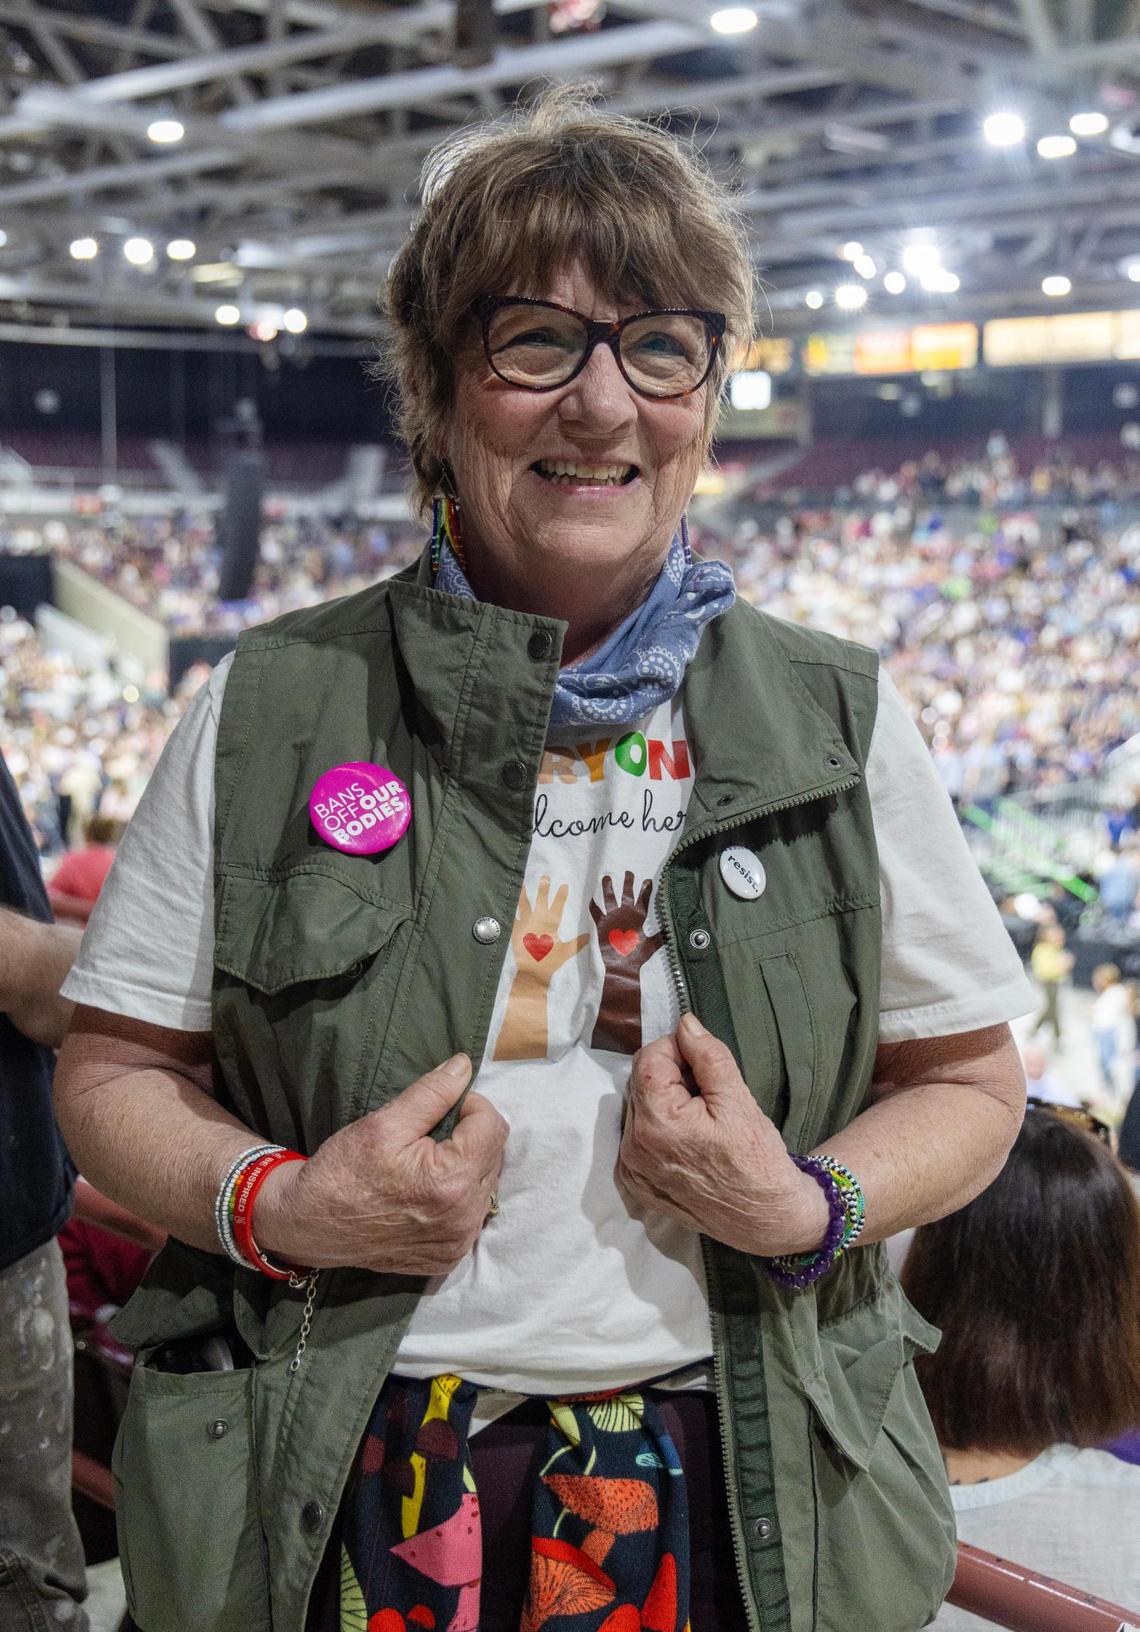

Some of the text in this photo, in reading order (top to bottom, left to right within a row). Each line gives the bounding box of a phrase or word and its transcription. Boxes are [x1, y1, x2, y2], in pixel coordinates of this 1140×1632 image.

[314, 783, 365, 819] BANS
[324, 781, 404, 831] OFF OUR
[332, 797, 405, 845] BODIES
[238, 1157, 274, 1212] BE INSPIRED
